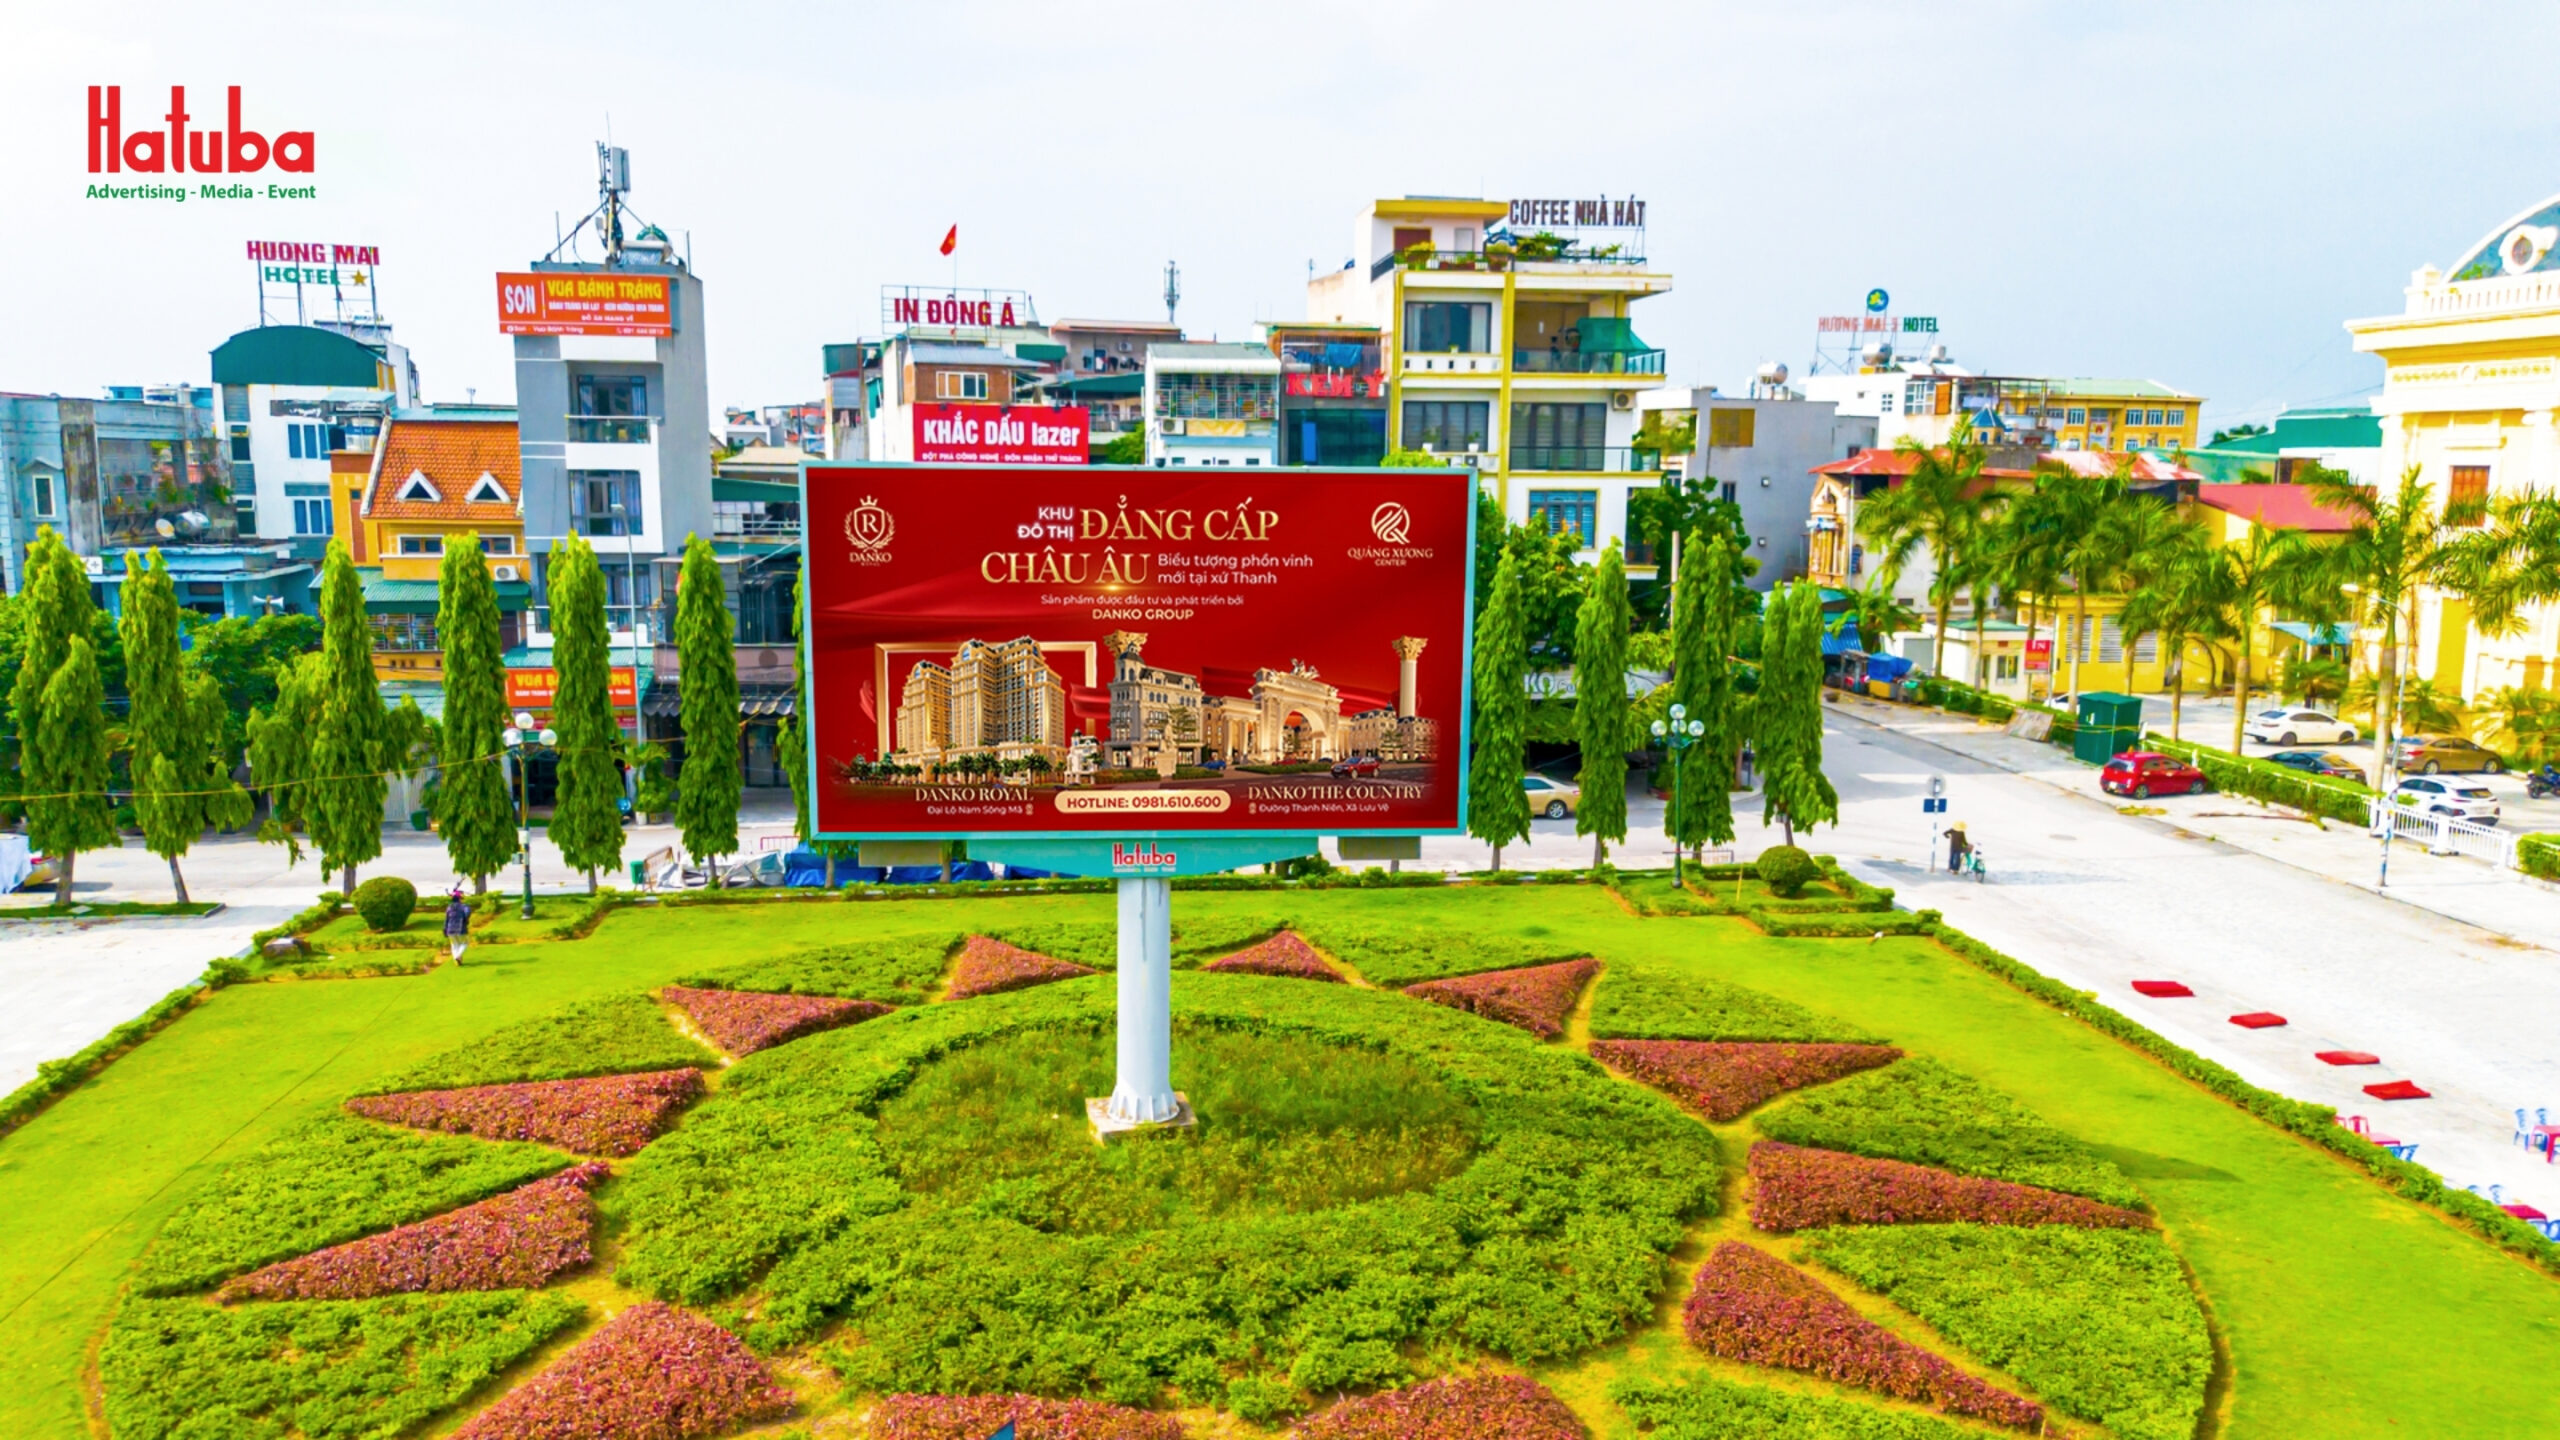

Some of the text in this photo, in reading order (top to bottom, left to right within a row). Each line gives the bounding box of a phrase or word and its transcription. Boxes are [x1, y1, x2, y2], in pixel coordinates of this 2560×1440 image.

[1509, 193, 1646, 226] COFFEE NHÀ HÁT
[333, 244, 380, 266] MAI
[264, 266, 341, 285] HOTEL
[547, 277, 663, 300] VUA BÁNH TRÁNG
[504, 284, 536, 314] SON
[894, 294, 1016, 327] IN ĐÔNG Á
[1903, 317, 1939, 332] HOTEL
[1285, 373, 1353, 398] KEM
[923, 411, 1081, 447] KHẮC DẤU lazer
[1038, 506, 1074, 520] KHU
[1079, 494, 1279, 541] ĐẲNG CẤP
[862, 513, 879, 533] R
[1016, 522, 1074, 542] ĐÔ THỊ
[849, 552, 892, 563] DANKO
[980, 545, 1151, 584] CHÂU ÂU
[1158, 552, 1313, 570] Biểu tượng phồn vinh
[1374, 559, 1407, 567] CENTER
[1158, 570, 1278, 586] mới tại xứ Thanh
[1175, 594, 1199, 607] phát
[1092, 609, 1194, 619] DANKO GROUP
[515, 674, 542, 687] VUA
[915, 787, 1034, 801] DANKO ROYAL
[1248, 785, 1425, 800] DANKO THE COUNTRY
[958, 806, 981, 815] Nam
[982, 805, 1007, 817] Sông
[1067, 796, 1221, 808] HOTLINE: 0981.610.600
[1292, 803, 1320, 812] Thanh
[1113, 842, 1176, 865] Hatuba
